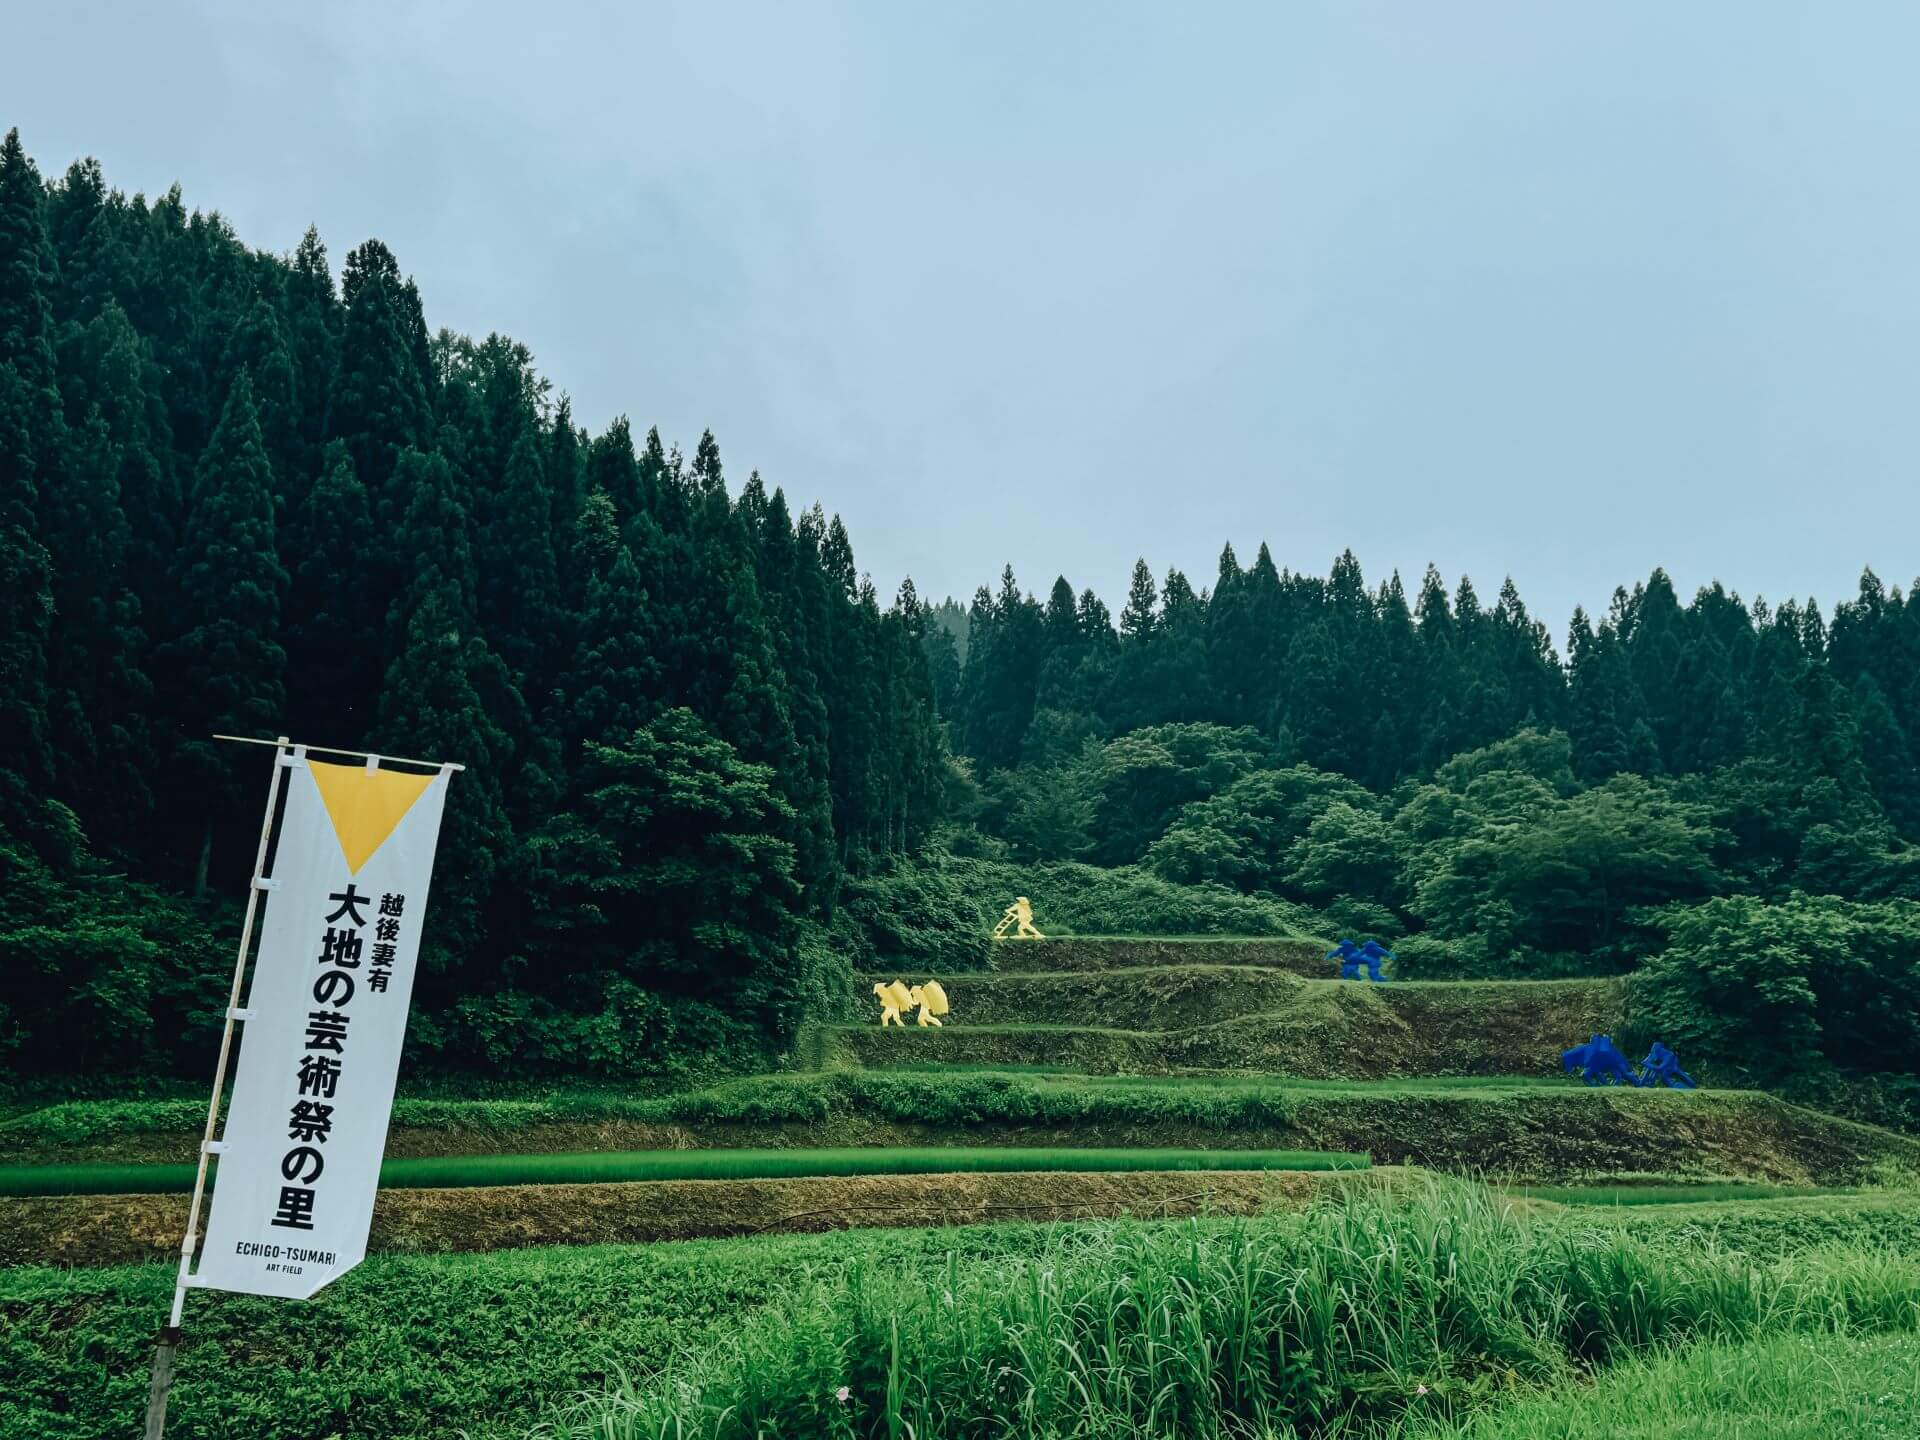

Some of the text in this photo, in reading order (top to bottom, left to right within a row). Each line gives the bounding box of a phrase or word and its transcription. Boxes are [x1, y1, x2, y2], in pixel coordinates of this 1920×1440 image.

[367, 893, 405, 993] 越後妻有
[271, 884, 370, 1230] 大地の芸術祭の里
[236, 1242, 335, 1265] ECHIGO-TSUMARI
[266, 1263, 302, 1274] ART FIELD
